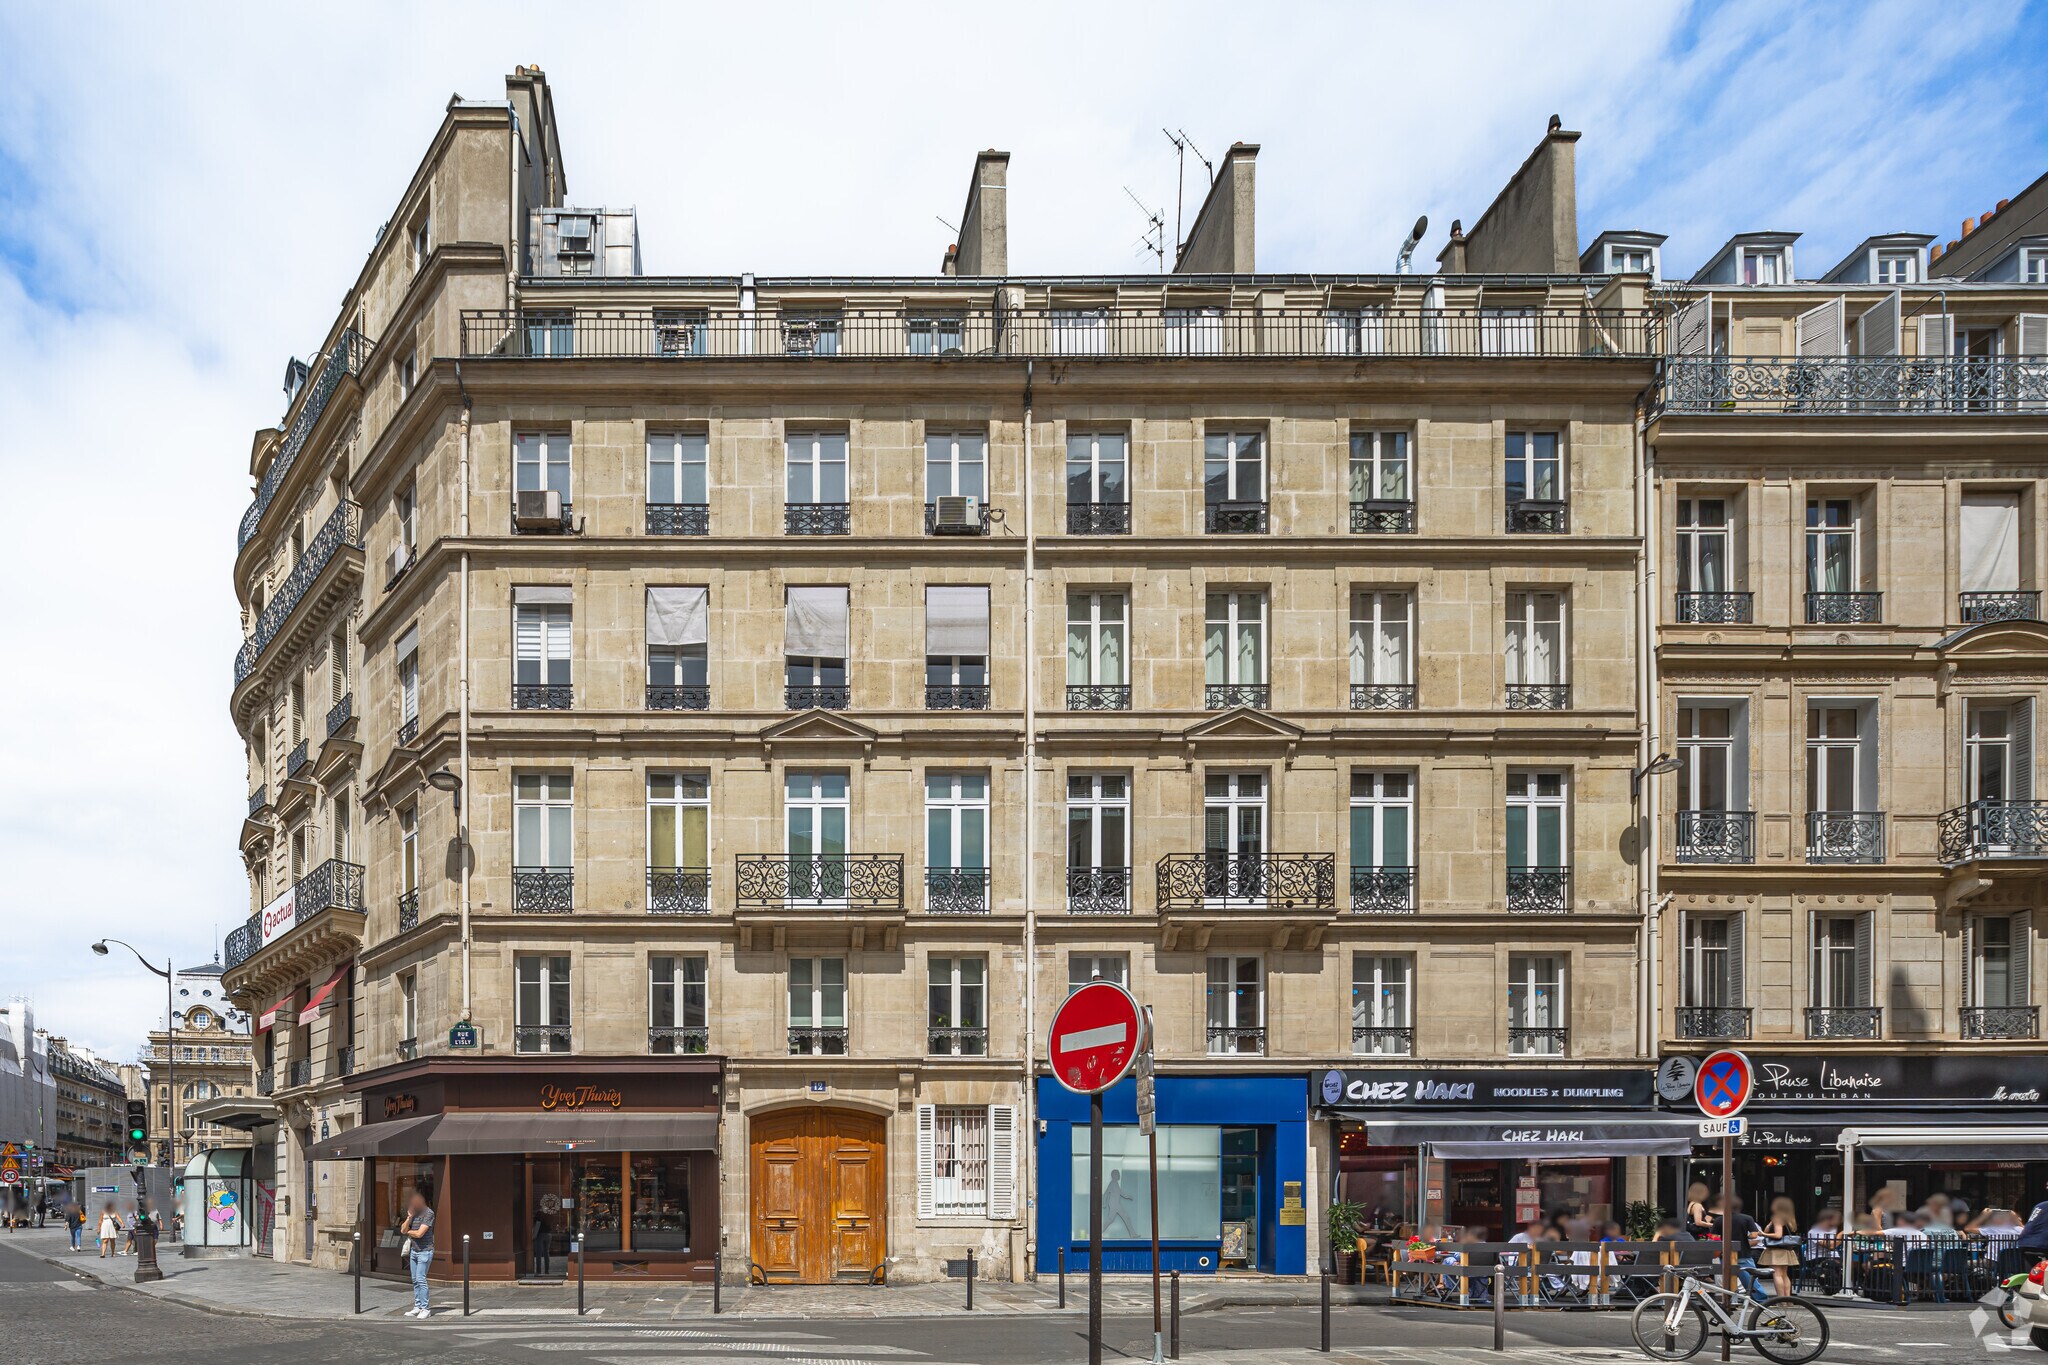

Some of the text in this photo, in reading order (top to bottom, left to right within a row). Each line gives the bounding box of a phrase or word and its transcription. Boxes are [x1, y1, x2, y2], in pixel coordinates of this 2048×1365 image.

[272, 896, 294, 927] actual
[1762, 1063, 1810, 1091] Pause
[1820, 1060, 1883, 1091] Libanaise
[814, 1082, 823, 1091] 12
[1347, 1079, 1475, 1100] CHEZ HAKI
[1493, 1087, 1624, 1098] NOODLES x DUMPLING
[541, 1084, 576, 1109] Yves
[1703, 1122, 1727, 1133] SAUF
[1501, 1129, 1584, 1142] CHEZ HAKI
[5, 1172, 16, 1180] 30
